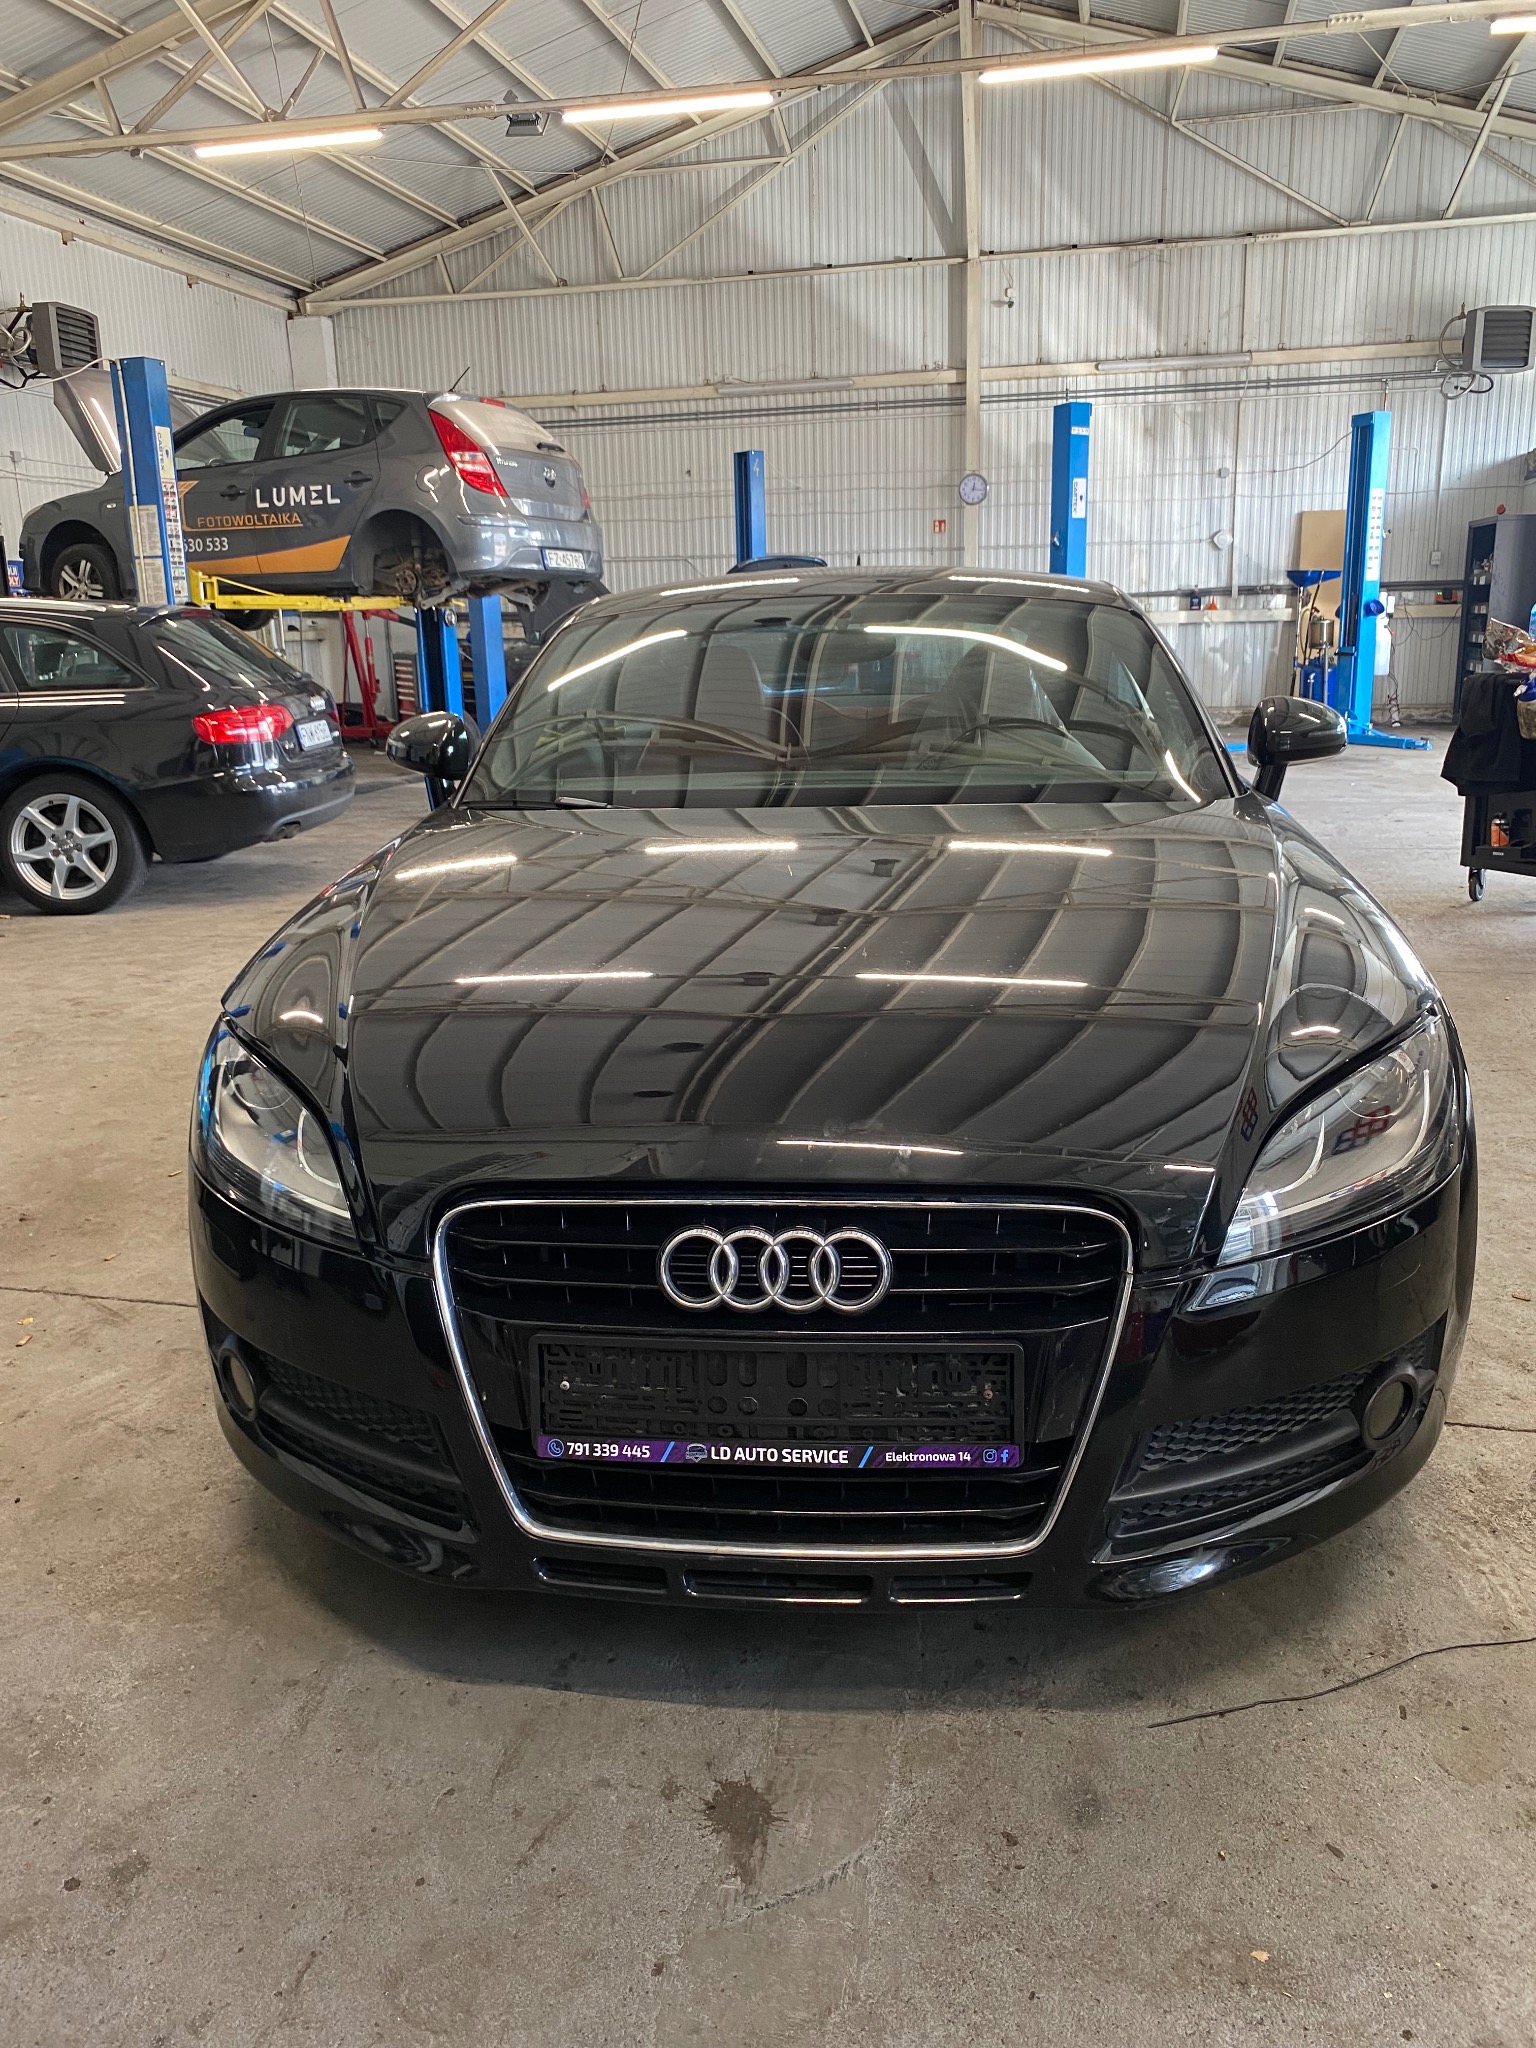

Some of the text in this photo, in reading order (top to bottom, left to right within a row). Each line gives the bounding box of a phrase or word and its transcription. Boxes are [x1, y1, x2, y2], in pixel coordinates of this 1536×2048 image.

[255, 484, 341, 509] LUMEL
[197, 512, 302, 527] FOTOWOLTAIKA
[206, 537, 229, 552] 533
[566, 1442, 650, 1458] 791 339 445
[710, 1446, 849, 1464] LD AUTO SERVICE
[885, 1451, 971, 1463] Elektronowa 14
